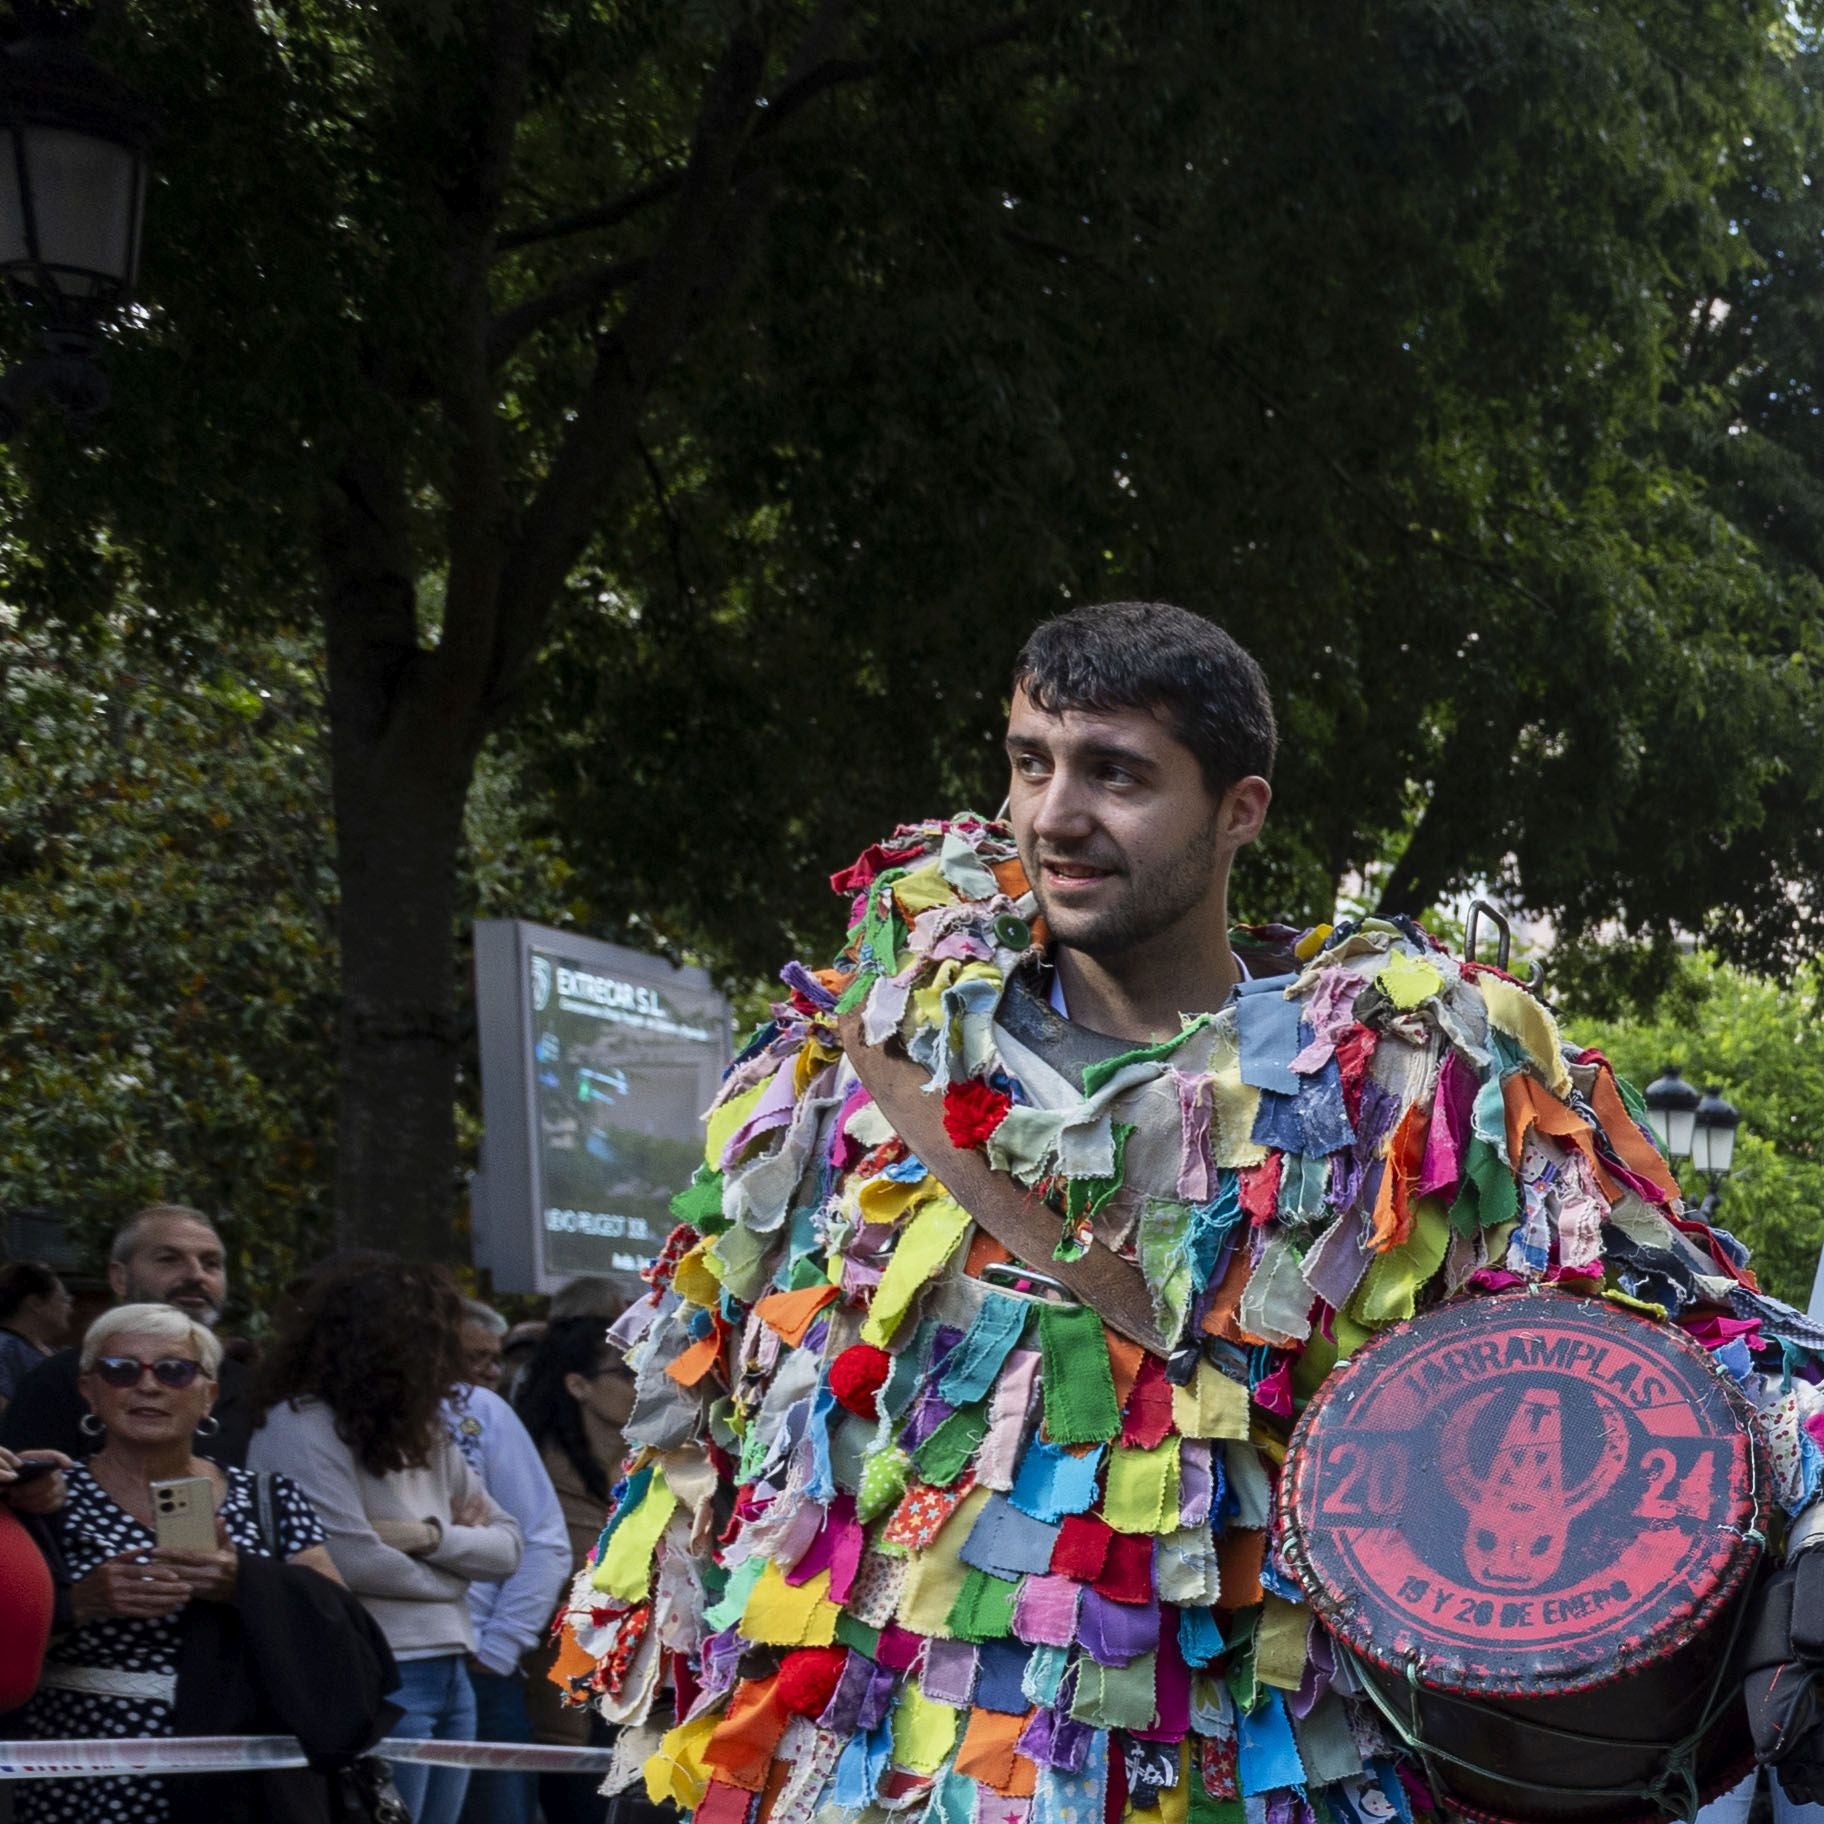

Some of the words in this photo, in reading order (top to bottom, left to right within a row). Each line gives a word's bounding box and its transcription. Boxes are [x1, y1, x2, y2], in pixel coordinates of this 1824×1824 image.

[1322, 1441, 1407, 1516] 20
[1455, 1597, 1495, 1627] 20
[1500, 1601, 1535, 1628] DE
